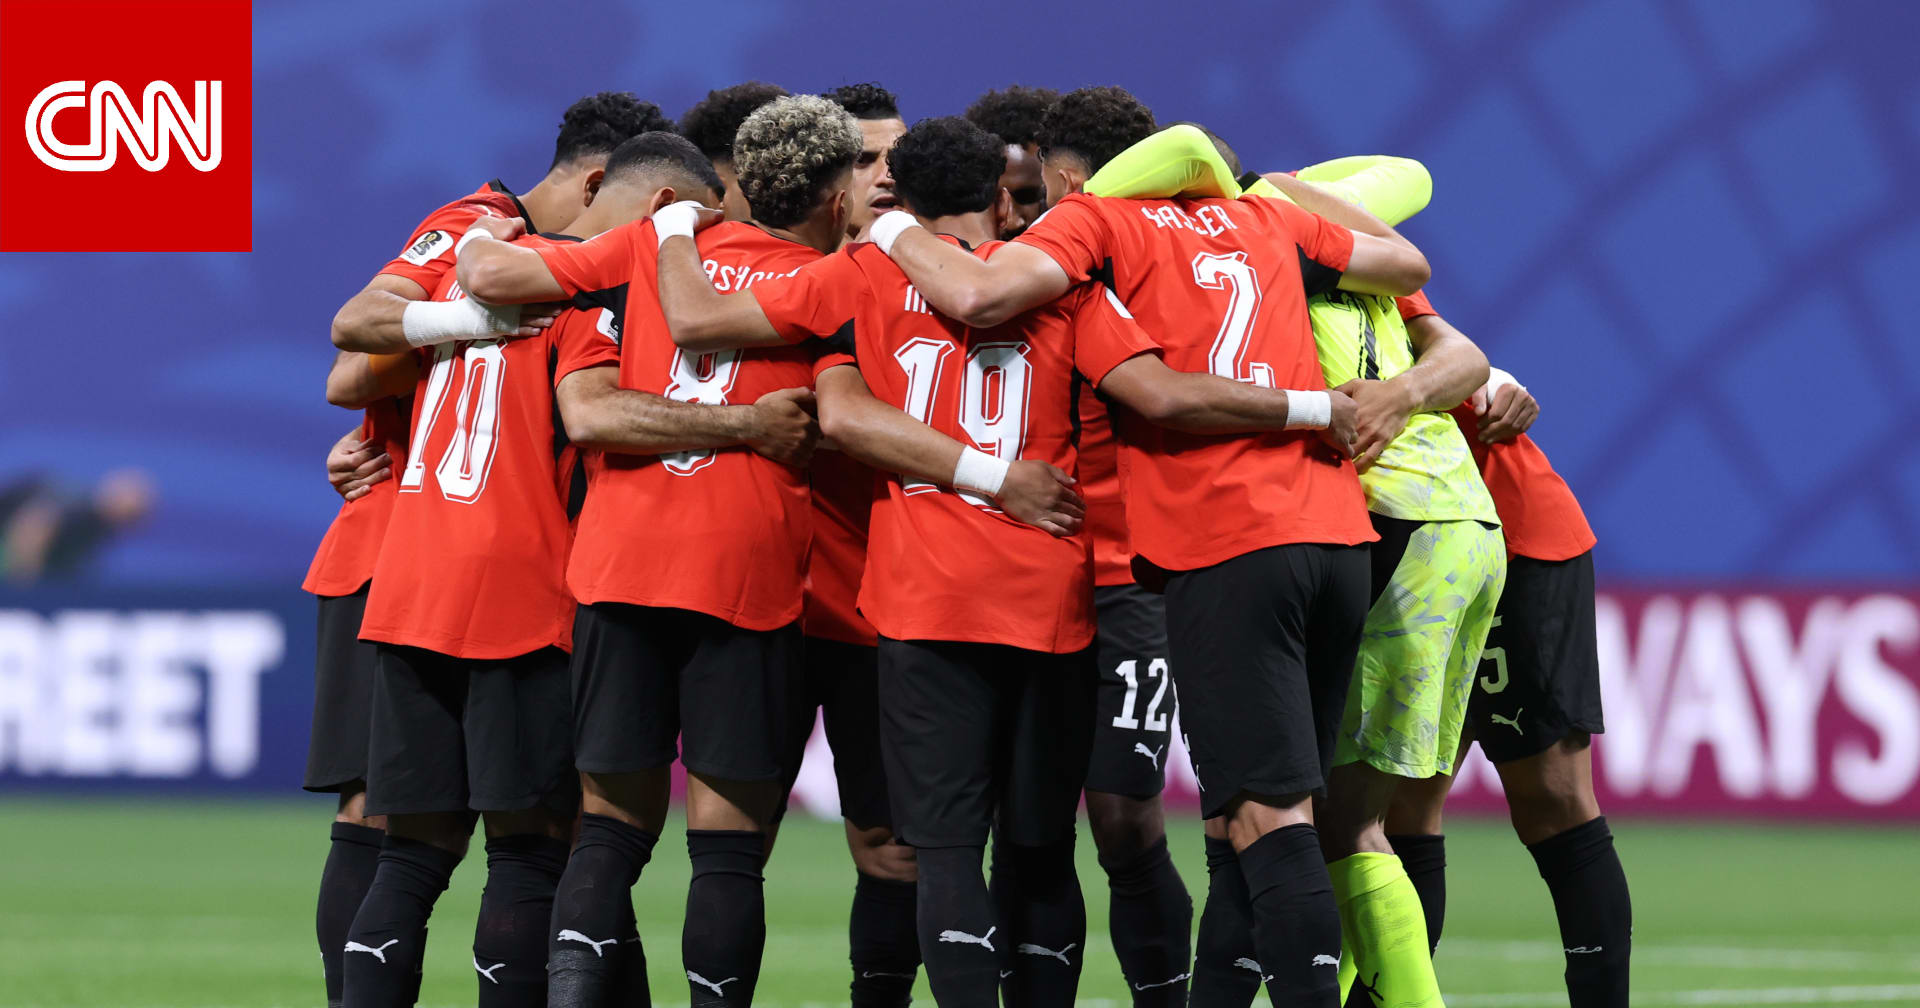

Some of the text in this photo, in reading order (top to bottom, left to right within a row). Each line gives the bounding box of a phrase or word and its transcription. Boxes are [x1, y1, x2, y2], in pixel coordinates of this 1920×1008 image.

[1192, 251, 1275, 388] 2
[399, 336, 508, 504] 10
[661, 346, 744, 477] 8
[893, 336, 1033, 514] 19
[1112, 658, 1168, 732] 12
